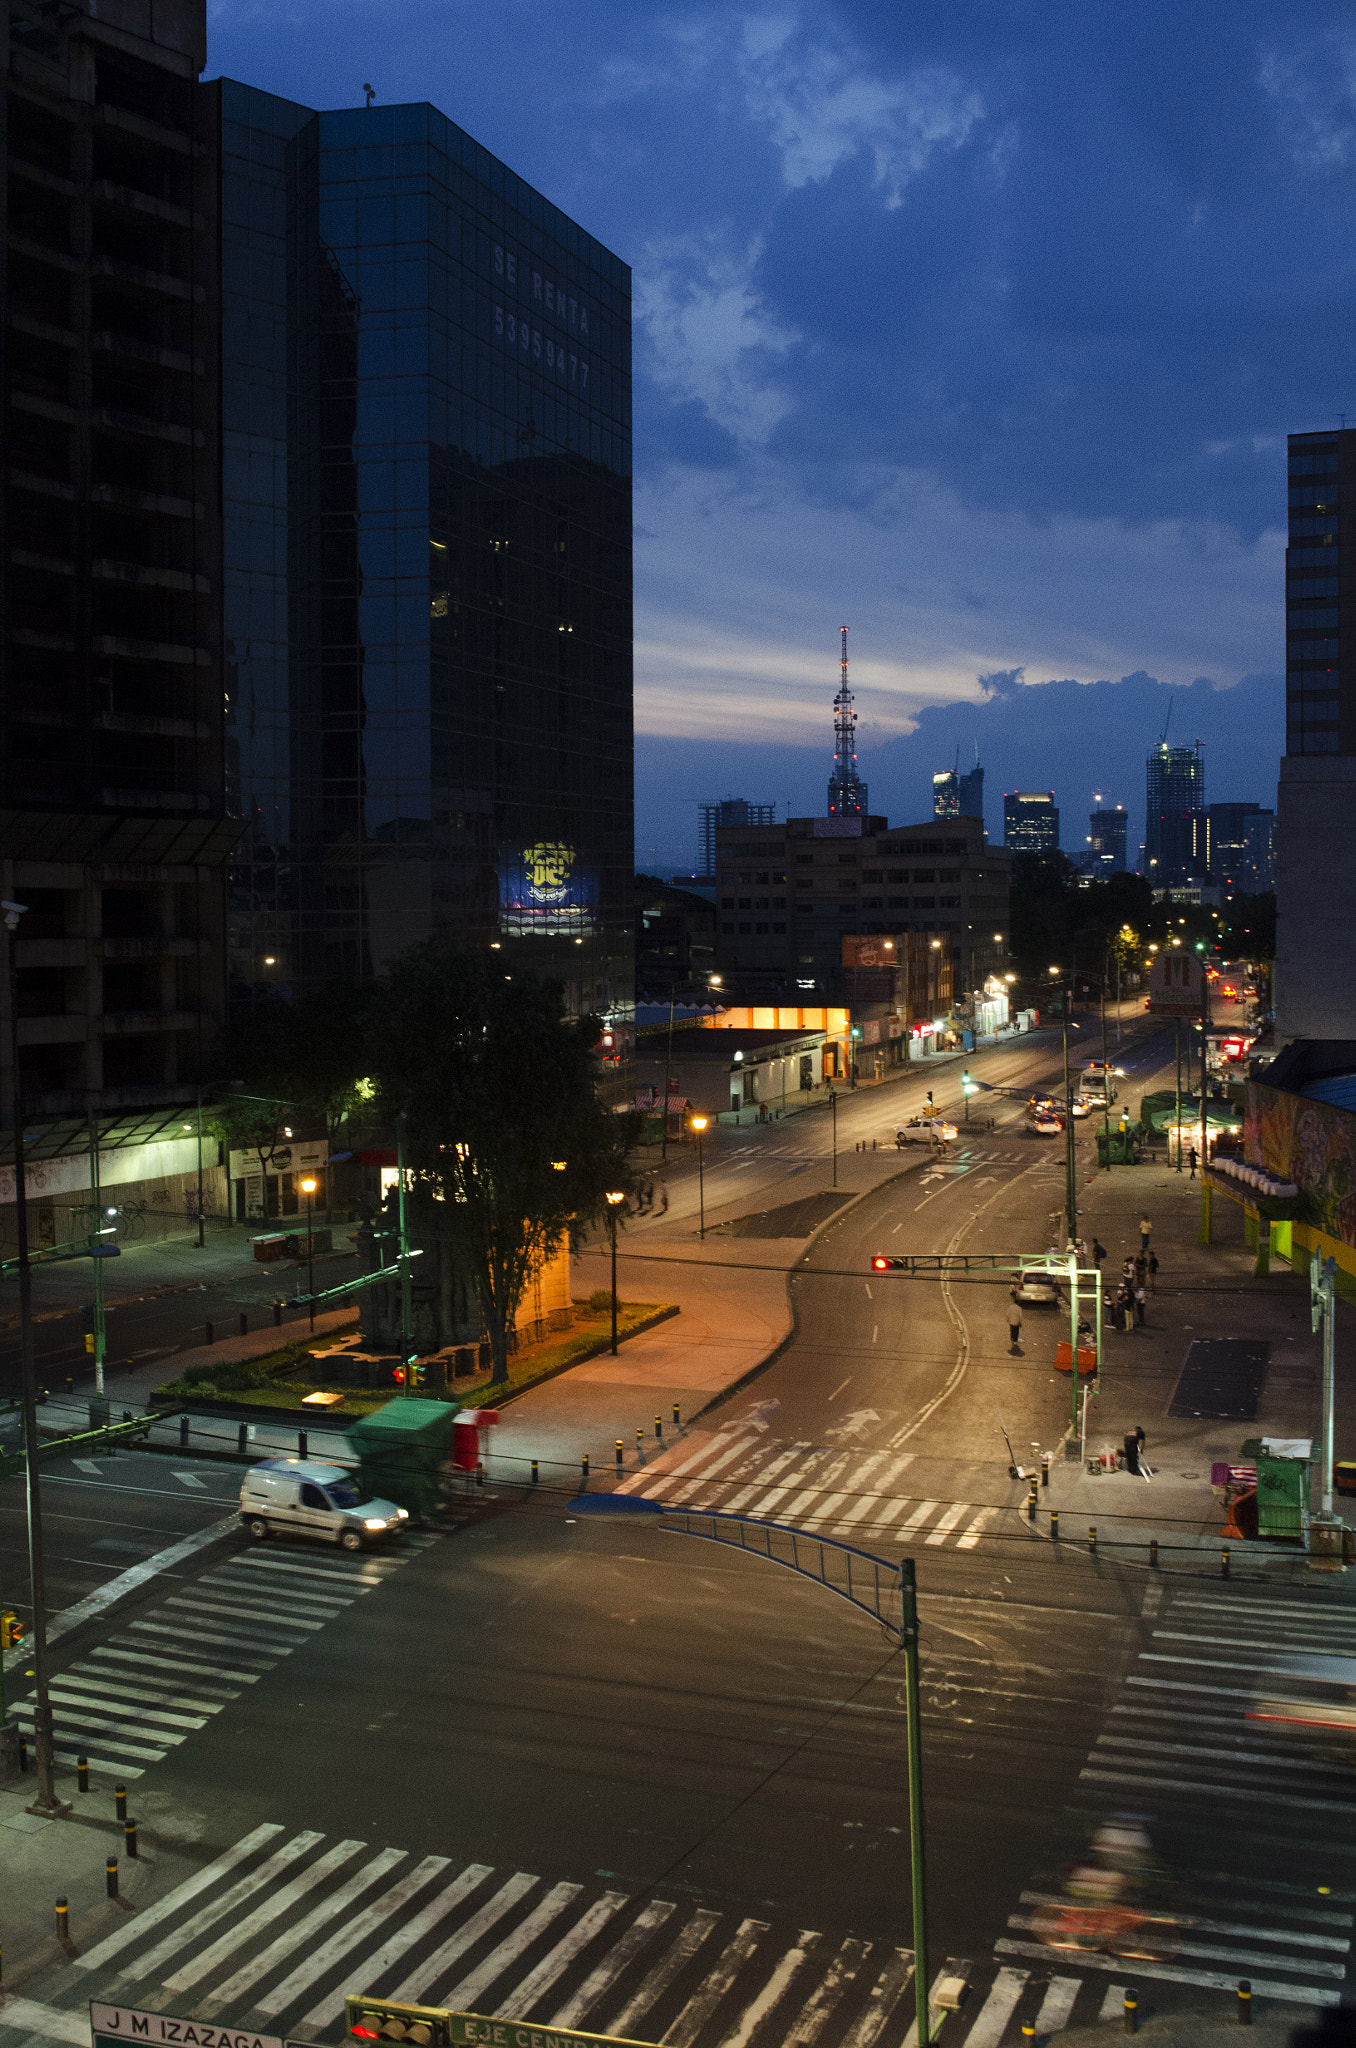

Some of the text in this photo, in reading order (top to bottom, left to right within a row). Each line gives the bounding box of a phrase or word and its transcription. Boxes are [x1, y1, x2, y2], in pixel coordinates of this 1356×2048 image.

[495, 245, 589, 335] SE RENTA
[494, 306, 590, 389] 53959477
[107, 2012, 264, 2048] J M IZAZAGA
[464, 2022, 506, 2043] EJE
